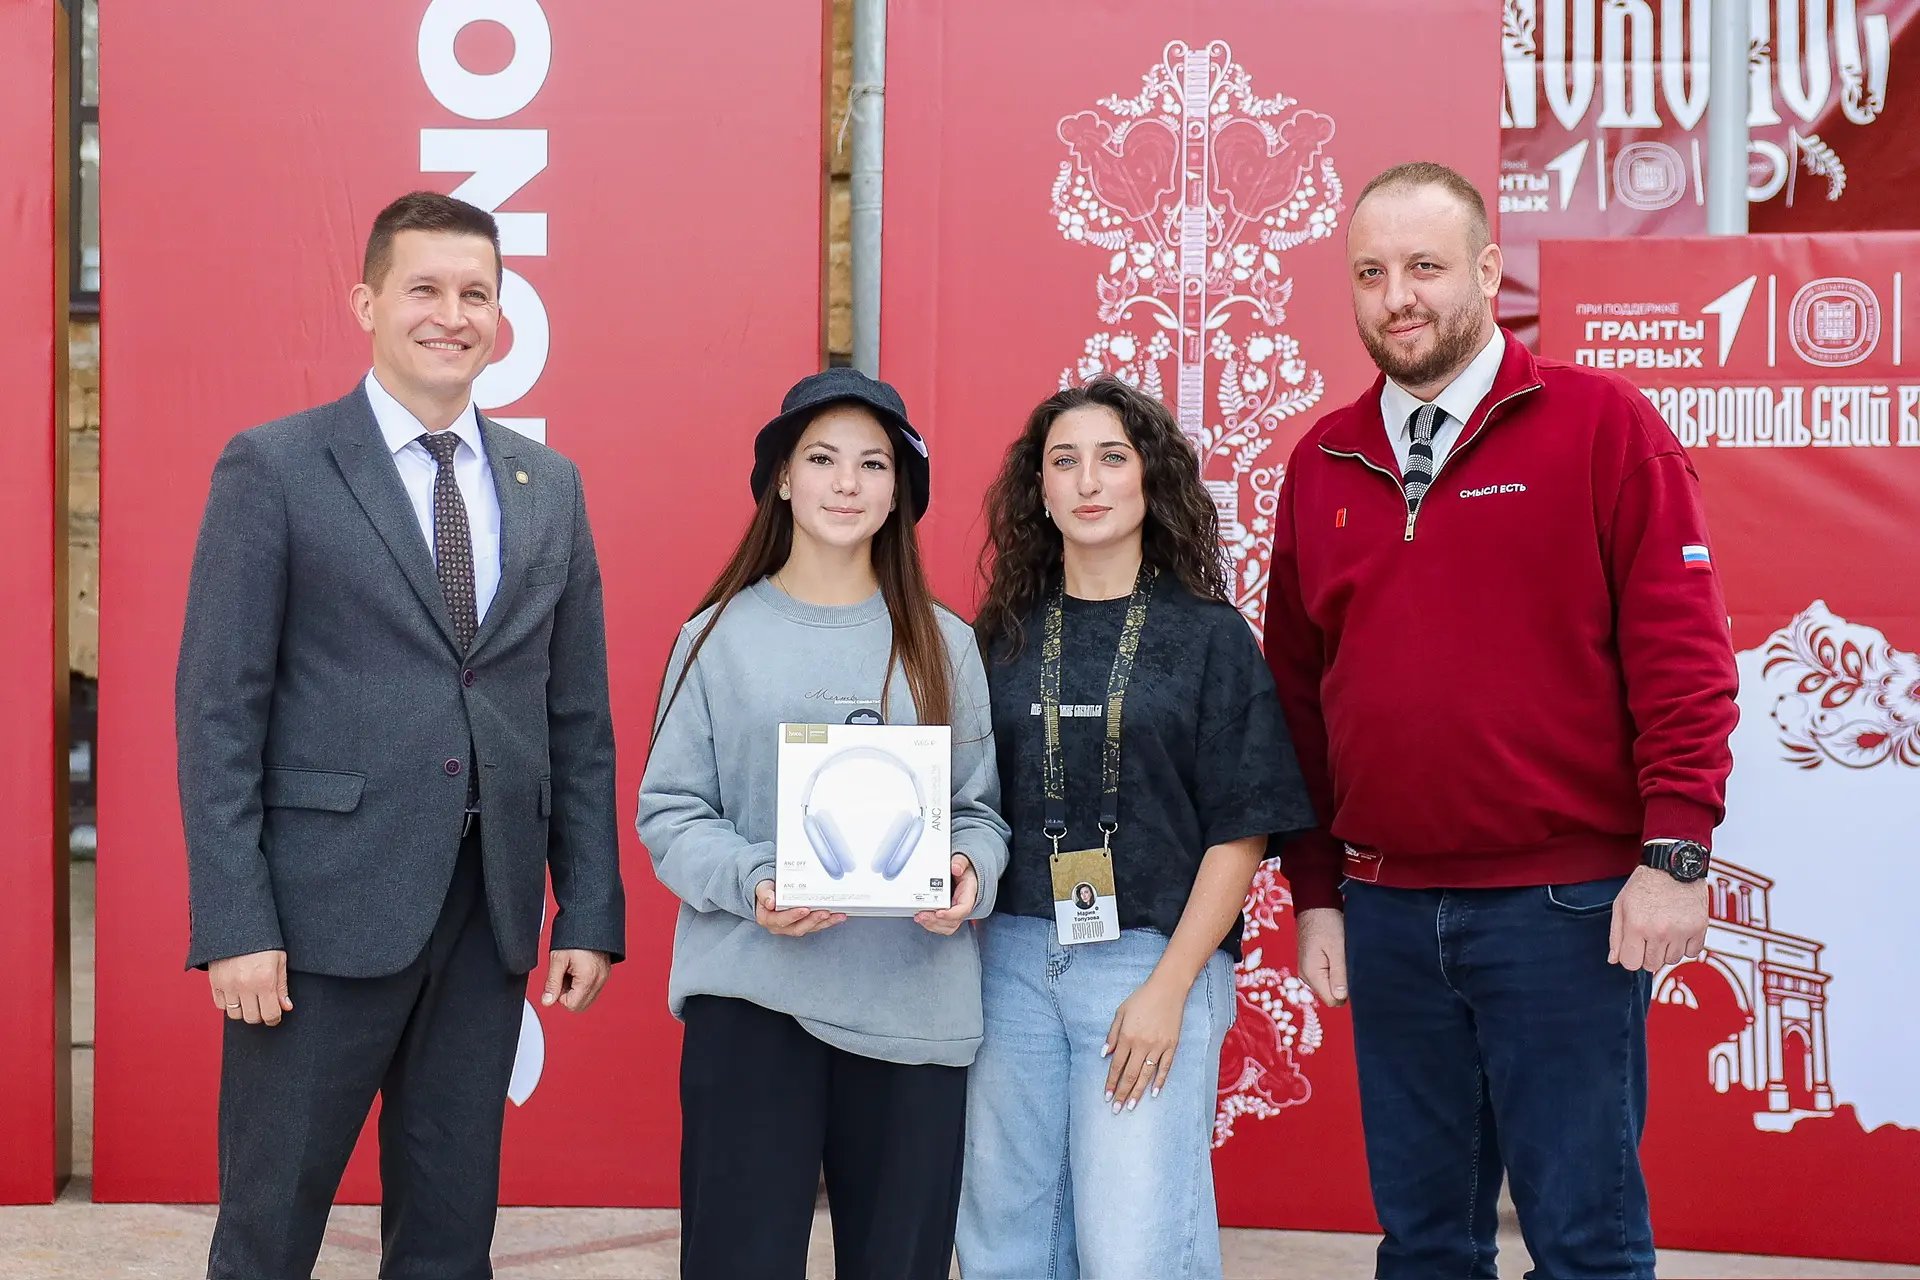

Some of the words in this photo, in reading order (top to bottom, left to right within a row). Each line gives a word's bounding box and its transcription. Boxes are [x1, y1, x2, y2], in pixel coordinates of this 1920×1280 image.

[1585, 319, 1705, 341] ГРАНТЫ
[1575, 347, 1704, 368] ПЕРВЫХ
[1459, 485, 1498, 499] СМЫСЛ
[1499, 483, 1527, 494] ЕСТЬ
[931, 807, 942, 831] ANC
